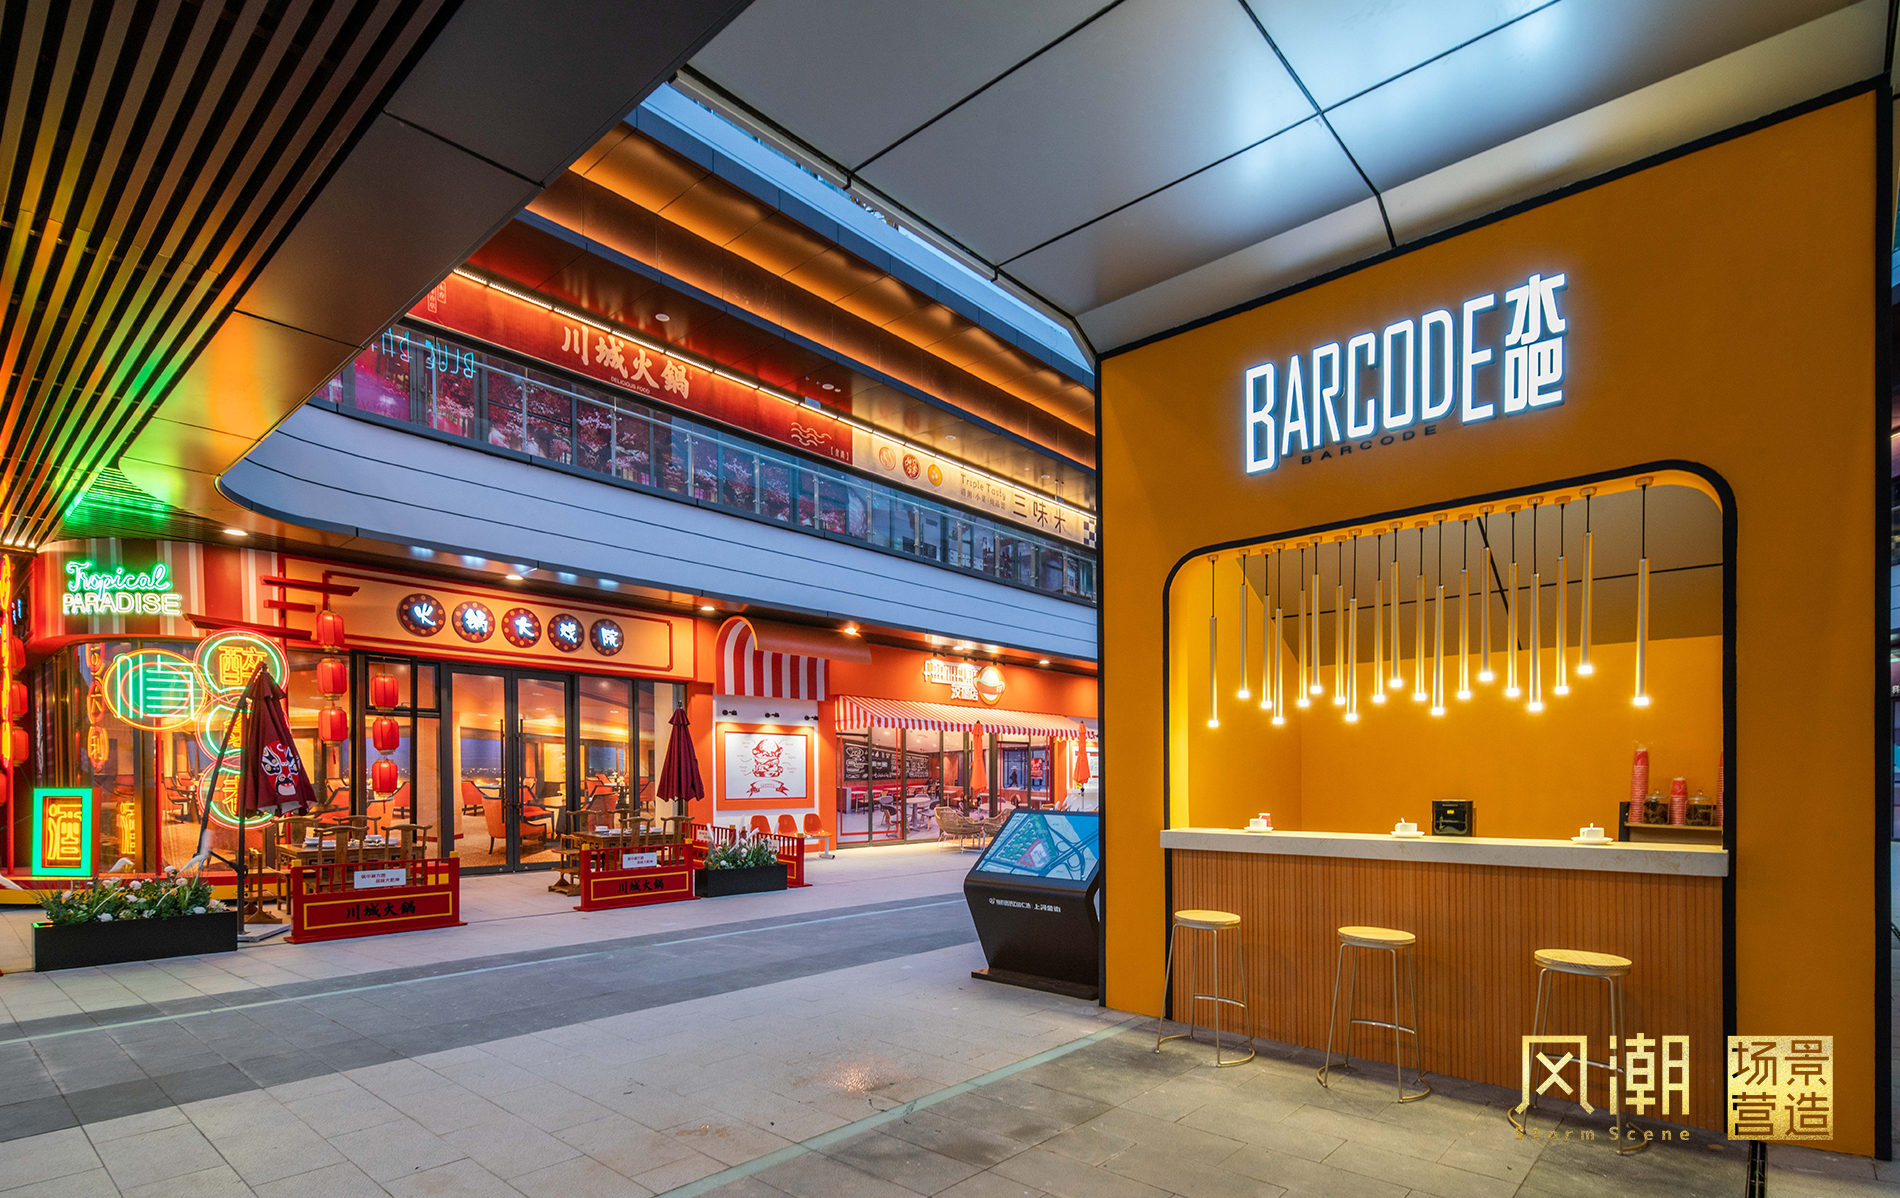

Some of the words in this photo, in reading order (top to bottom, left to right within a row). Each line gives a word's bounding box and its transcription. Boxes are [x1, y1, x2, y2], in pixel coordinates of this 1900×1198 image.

[1503, 272, 1567, 414] 水吧
[610, 376, 637, 391] DELICIOUS
[636, 384, 651, 394] FOOD
[1245, 292, 1497, 476] BARCODE
[1301, 424, 1438, 465] BARCODE
[960, 473, 985, 491] Triple
[986, 483, 1007, 501] Tasty
[65, 561, 172, 600] Tropical
[62, 592, 182, 615] PARADISE
